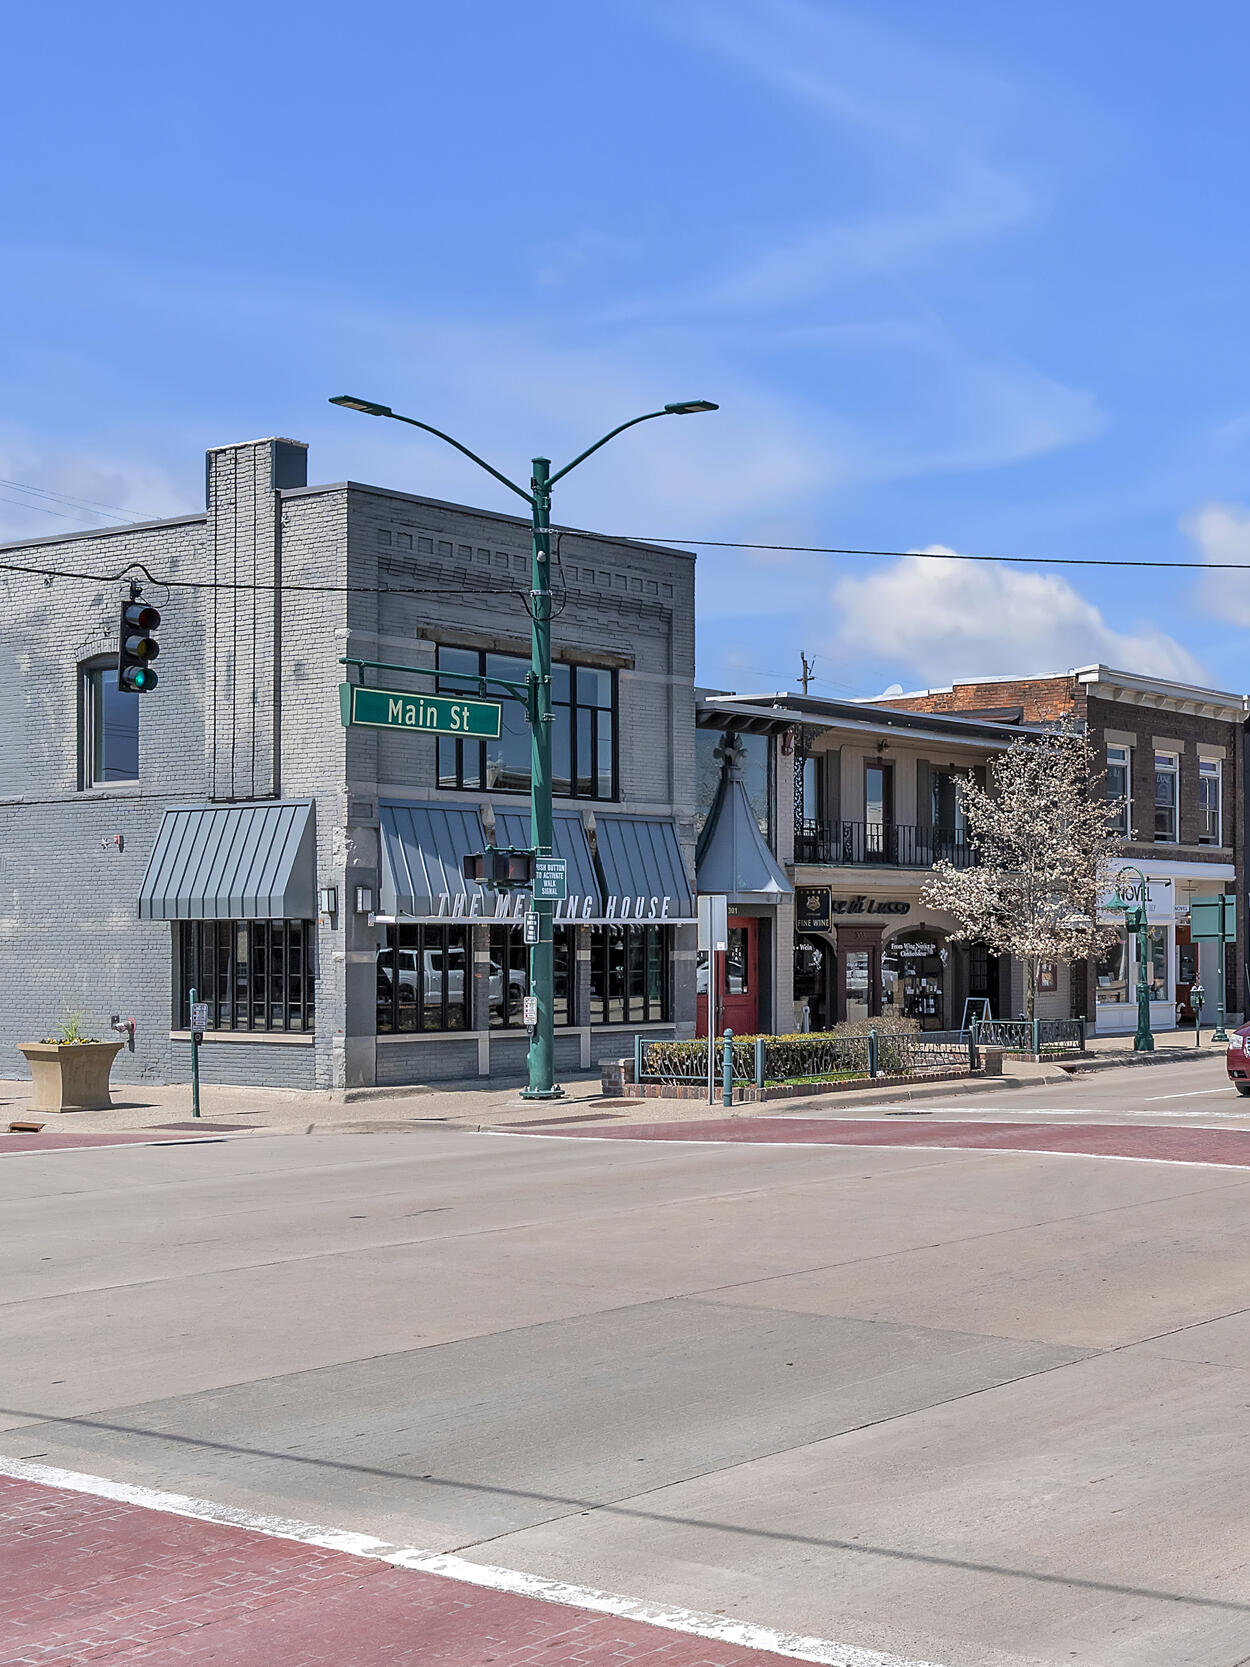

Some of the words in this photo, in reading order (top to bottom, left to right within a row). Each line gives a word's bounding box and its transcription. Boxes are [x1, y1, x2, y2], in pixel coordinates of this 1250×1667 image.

[388, 698, 438, 728] Main
[450, 705, 470, 731] St
[547, 864, 565, 872] BUTTON
[536, 871, 543, 879] TO
[543, 872, 564, 880] ACTIVATE
[438, 892, 481, 918] THE
[495, 894, 594, 919] MEING
[605, 895, 671, 919] HOUSE
[797, 919, 812, 927] FINE
[812, 919, 829, 927] WINE
